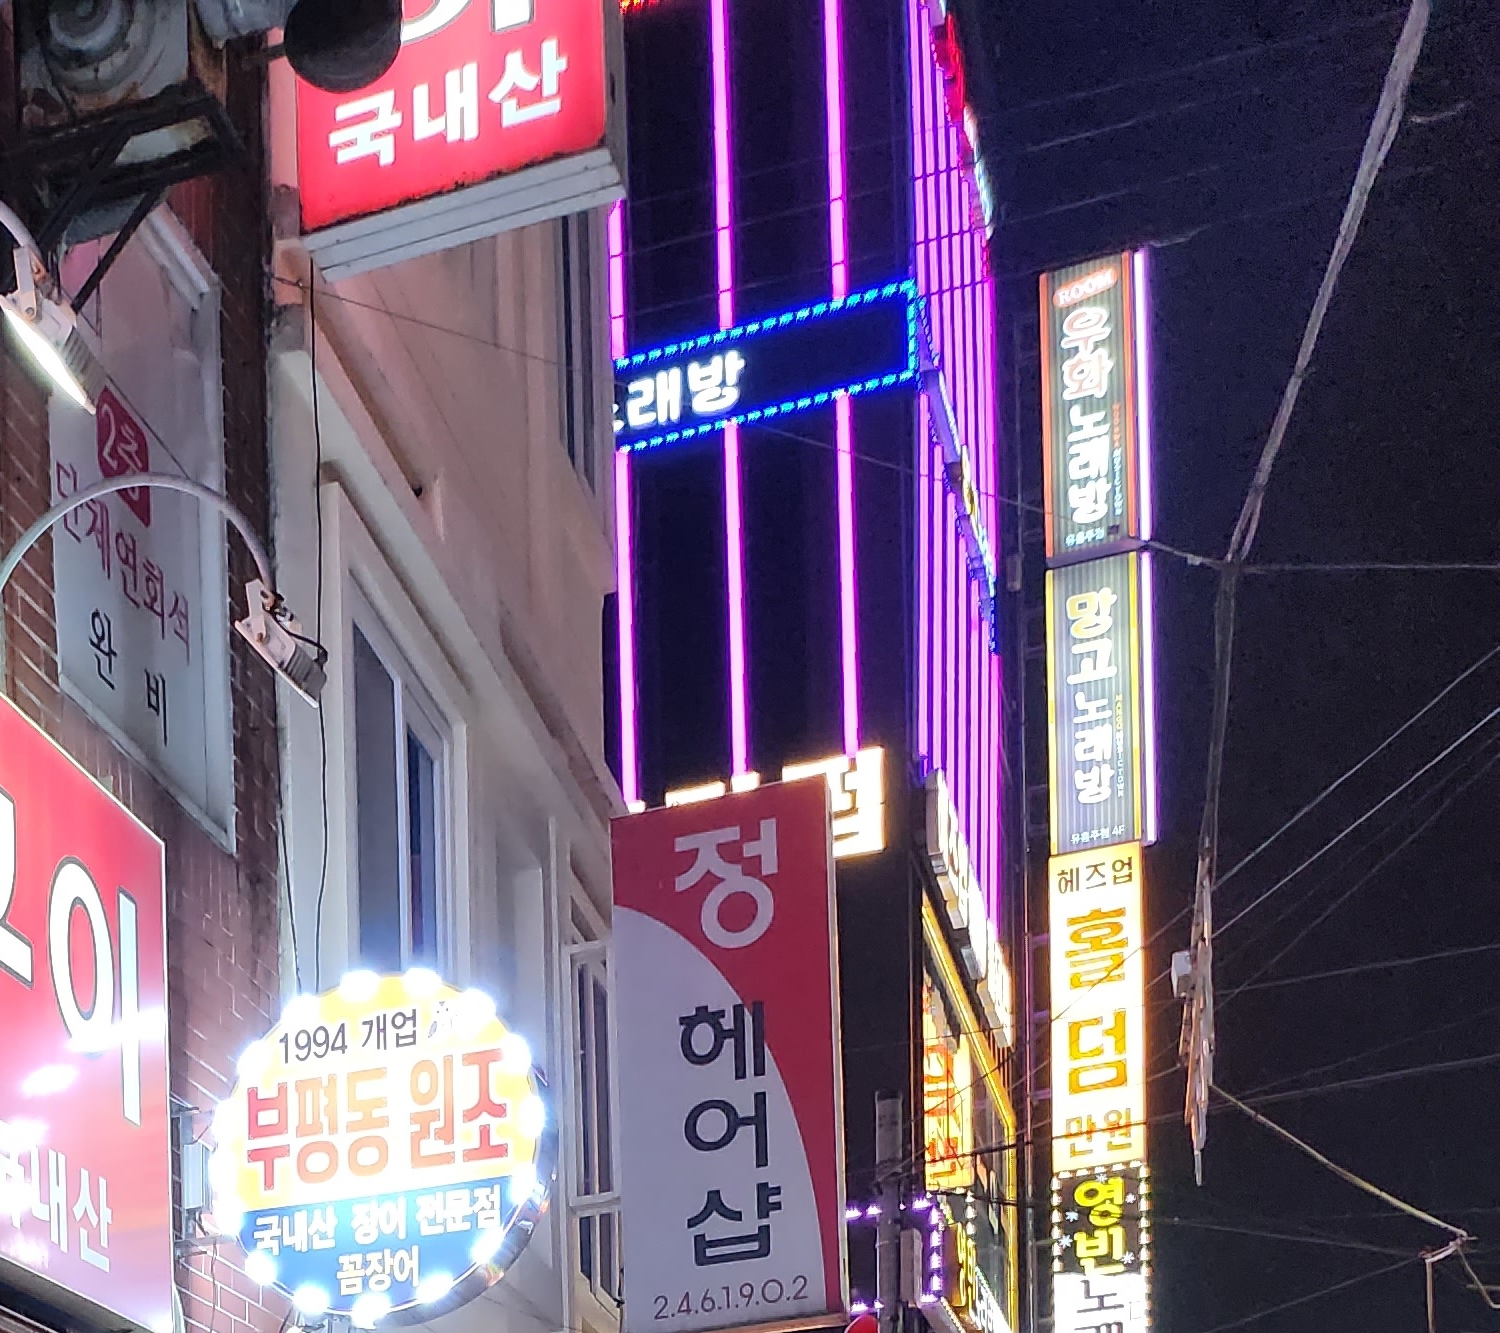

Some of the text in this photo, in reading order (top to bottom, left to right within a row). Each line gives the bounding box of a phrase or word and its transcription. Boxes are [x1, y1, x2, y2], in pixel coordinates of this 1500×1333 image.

[328, 39, 567, 167] 국내산
[1057, 268, 1116, 306] ROOM
[613, 349, 747, 431] 래방
[1067, 404, 1112, 524] 노래방
[56, 460, 190, 666] 단체연회석
[1073, 691, 1115, 805] 노래방
[1057, 856, 1133, 894] 헤즈업
[1112, 824, 1126, 837] 4F
[674, 816, 778, 949] 정
[279, 1008, 418, 1064] 1994 개업
[1065, 906, 1129, 1096] 홀덤
[247, 1048, 508, 1192] 부평동 원조
[678, 1001, 784, 1265] 헤어샵
[1065, 1107, 1132, 1159] 만원
[253, 1206, 338, 1257] 국내산
[415, 1184, 502, 1237] 전문점
[1073, 1176, 1127, 1275] 영빈
[335, 1244, 421, 1297] 꼼장어
